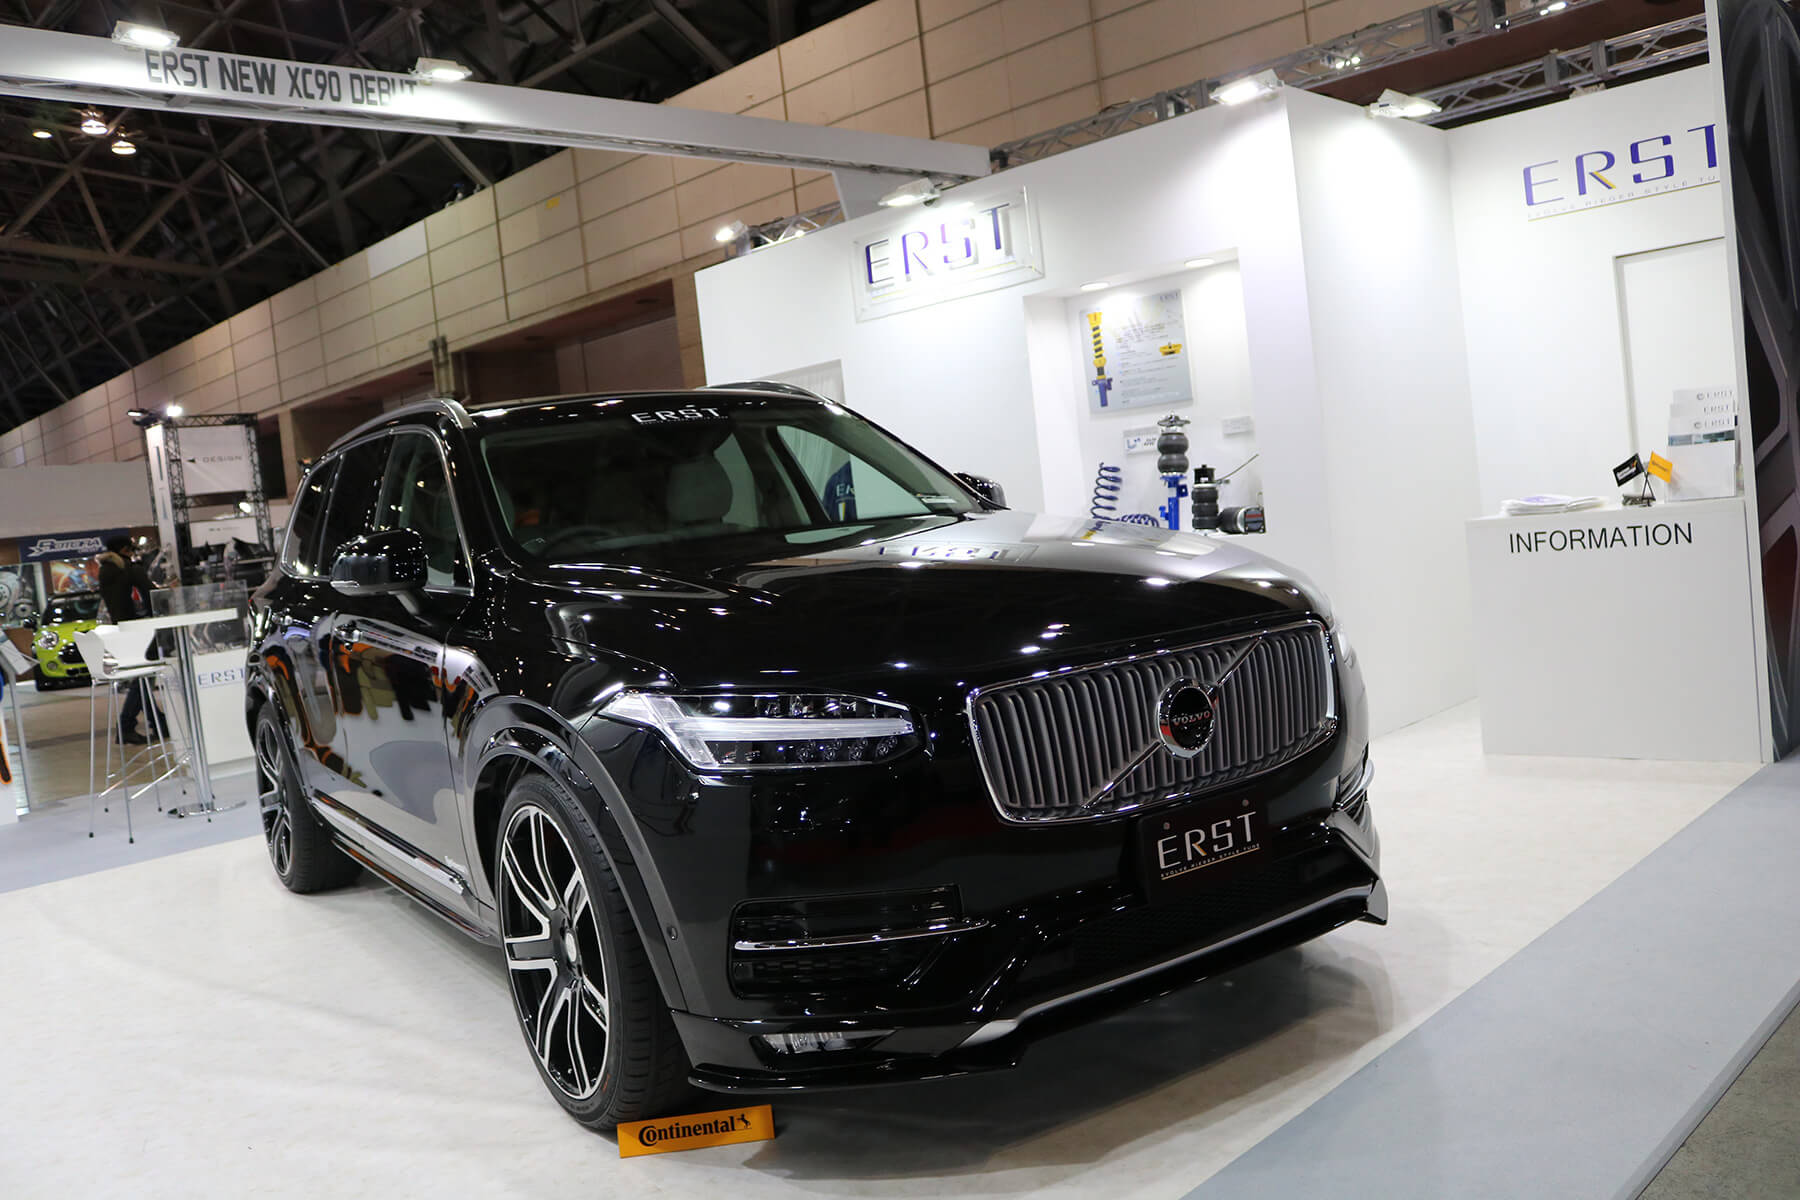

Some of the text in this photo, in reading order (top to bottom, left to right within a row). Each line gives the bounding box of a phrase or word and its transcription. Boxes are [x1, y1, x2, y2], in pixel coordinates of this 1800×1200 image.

[145, 48, 418, 106] ERST NEW XC90 DEBUT
[1522, 123, 1718, 207] ERST
[865, 203, 1010, 285] ERST
[631, 407, 720, 423] ERST
[1509, 522, 1693, 554] INFORMATION
[1172, 710, 1211, 726] VOLVO
[1157, 811, 1257, 869] ERST
[638, 1115, 736, 1147] Continental
